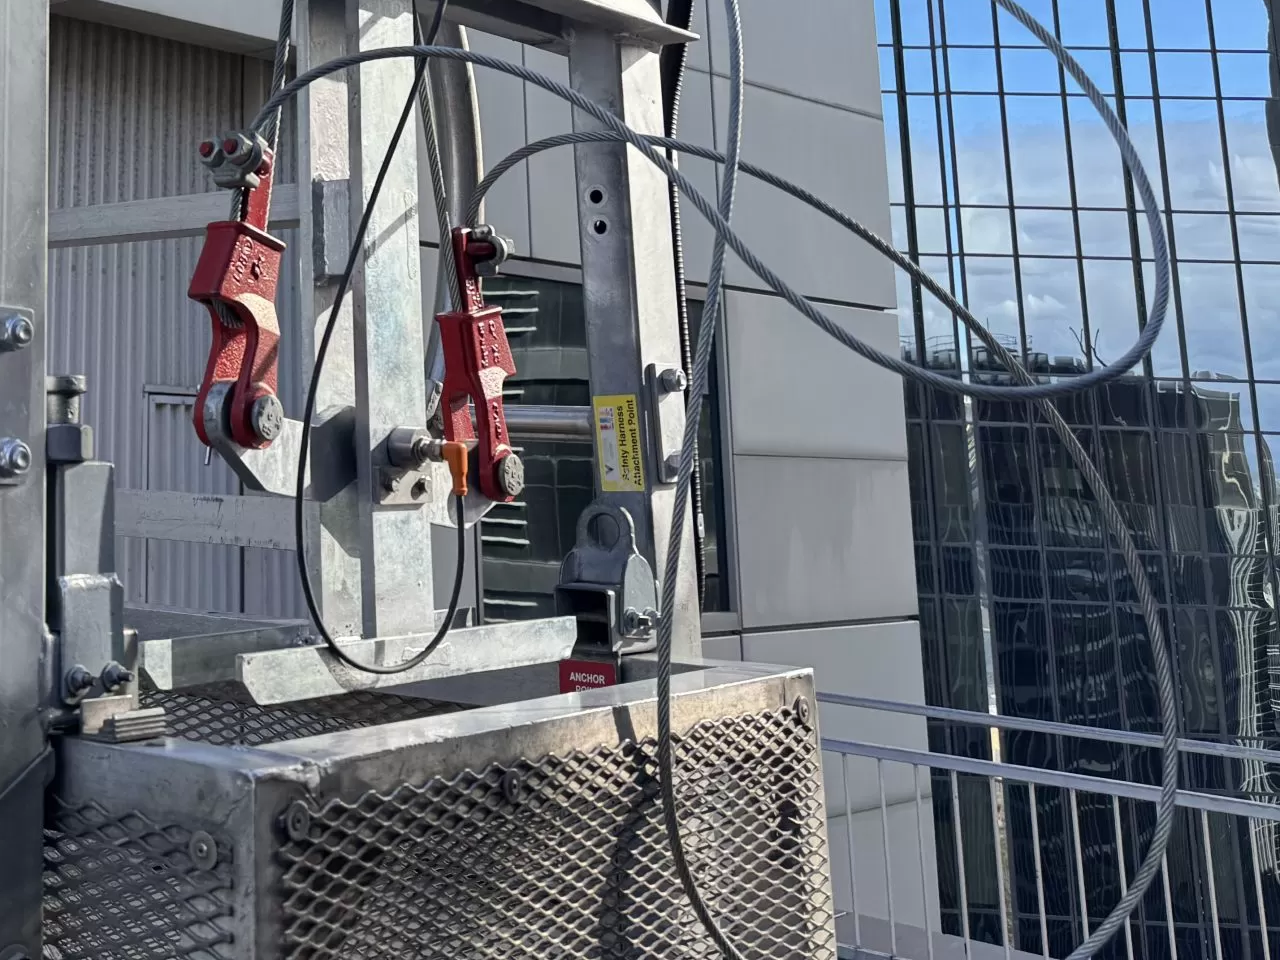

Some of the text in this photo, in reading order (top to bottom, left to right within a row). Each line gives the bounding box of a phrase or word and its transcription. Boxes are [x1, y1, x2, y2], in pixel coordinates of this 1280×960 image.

[617, 405, 627, 446] Harness
[626, 399, 636, 426] Point
[629, 428, 642, 485] Attachment
[570, 672, 605, 685] ANCHOR
